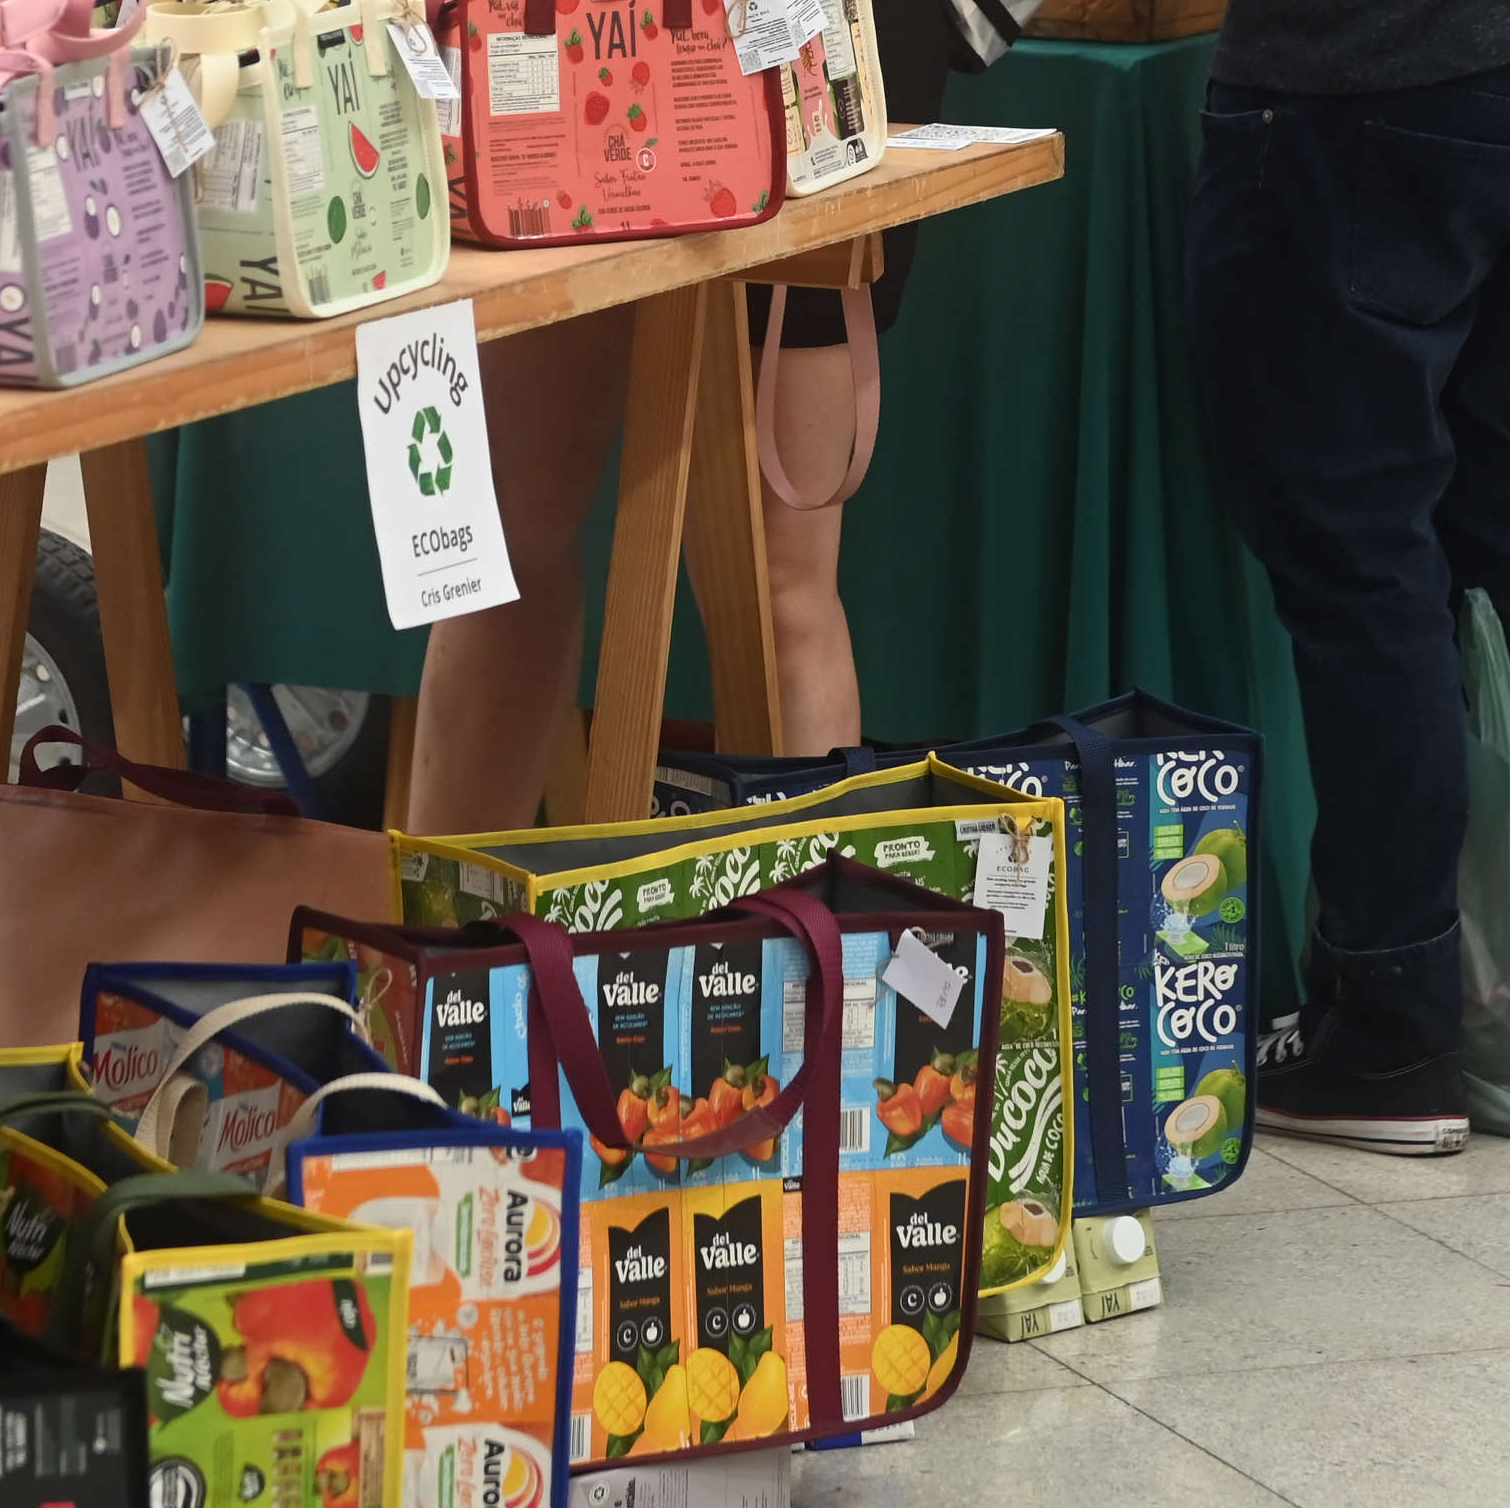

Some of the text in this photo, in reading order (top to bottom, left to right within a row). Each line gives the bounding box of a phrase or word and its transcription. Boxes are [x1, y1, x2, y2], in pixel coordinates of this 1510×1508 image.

[607, 131, 626, 148] CHÁ
[603, 147, 633, 163] VERDE
[642, 152, 650, 167] C
[594, 171, 618, 189] Sabor
[374, 332, 469, 415] Upcycling
[412, 525, 474, 558] ECObags
[421, 577, 482, 608] Cris Grenier
[883, 839, 921, 853] PRONTO
[884, 848, 921, 860] PARA BEBER!
[996, 865, 1030, 874] ECOBAG
[642, 883, 668, 897] PRONTO
[1229, 942, 1245, 952] litro
[712, 961, 729, 975] del
[616, 971, 634, 984] del
[698, 972, 756, 998] Valle
[1154, 961, 1238, 1007] KERO
[446, 988, 461, 1003] del
[602, 982, 660, 1007] Valle
[436, 999, 485, 1029] Valle
[92, 1045, 159, 1090] Molico
[988, 1048, 1057, 1183] Ducoco
[217, 1104, 277, 1153] Molico
[1042, 1150, 1055, 1164] DE
[5, 1201, 51, 1243] Nutri
[909, 1211, 929, 1227] del
[502, 1188, 529, 1284] Aurora
[712, 1232, 730, 1248] del
[895, 1222, 958, 1249] Valle
[626, 1245, 642, 1261] del
[700, 1242, 758, 1271] Valle
[615, 1256, 665, 1284] Valle
[902, 1262, 951, 1275] Sabor Manga
[707, 1282, 753, 1296] Sabor Manga
[619, 1296, 661, 1309] Sabor Manga
